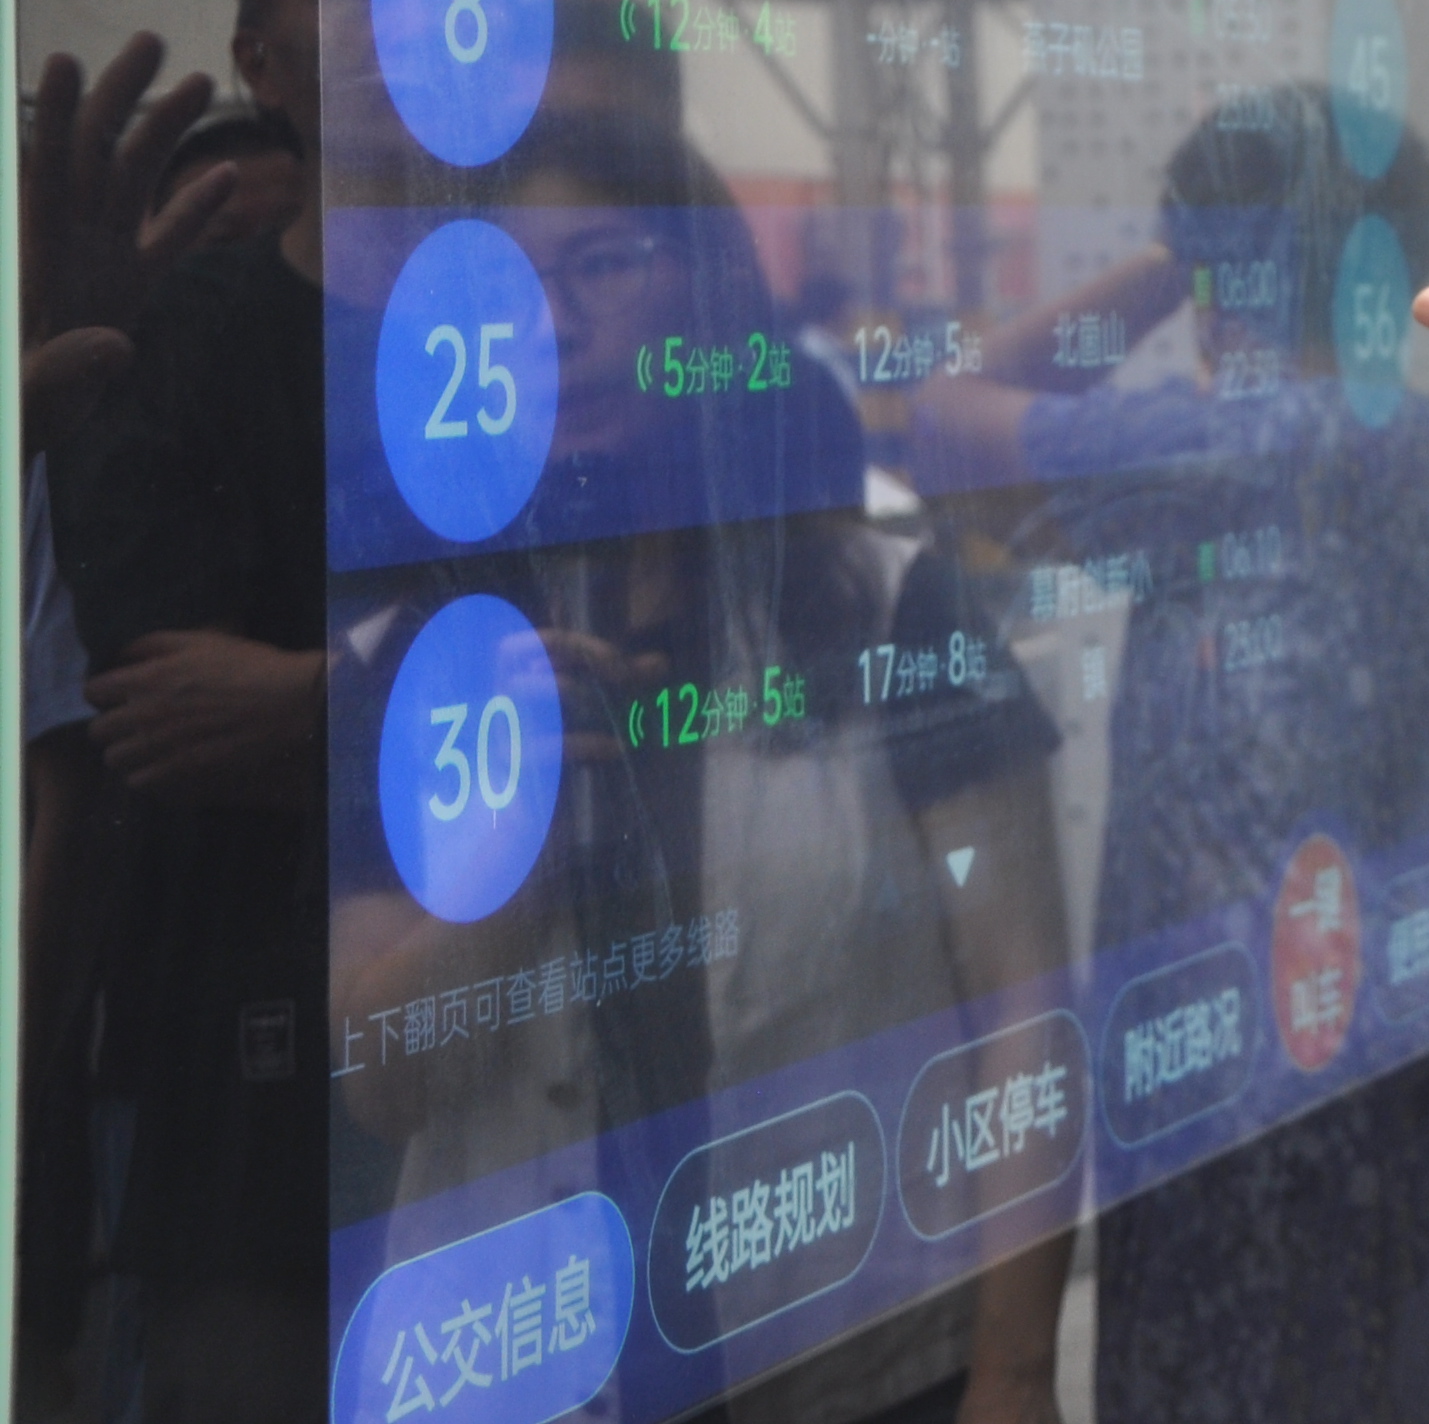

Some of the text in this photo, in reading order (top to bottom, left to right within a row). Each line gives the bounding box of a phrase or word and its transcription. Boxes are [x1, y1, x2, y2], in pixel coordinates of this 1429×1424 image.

[1348, 35, 1391, 113] 45
[424, 322, 518, 440] 25
[1353, 284, 1396, 361] 56
[427, 695, 522, 823] 30
[655, 665, 805, 748] 12分钟·5站
[858, 629, 988, 703] 17分钟·8站
[330, 907, 741, 1078] 上下翻页可查看站点更多线路
[382, 987, 1242, 1424] 公交信息 线路规划 小区停车 附近路况
